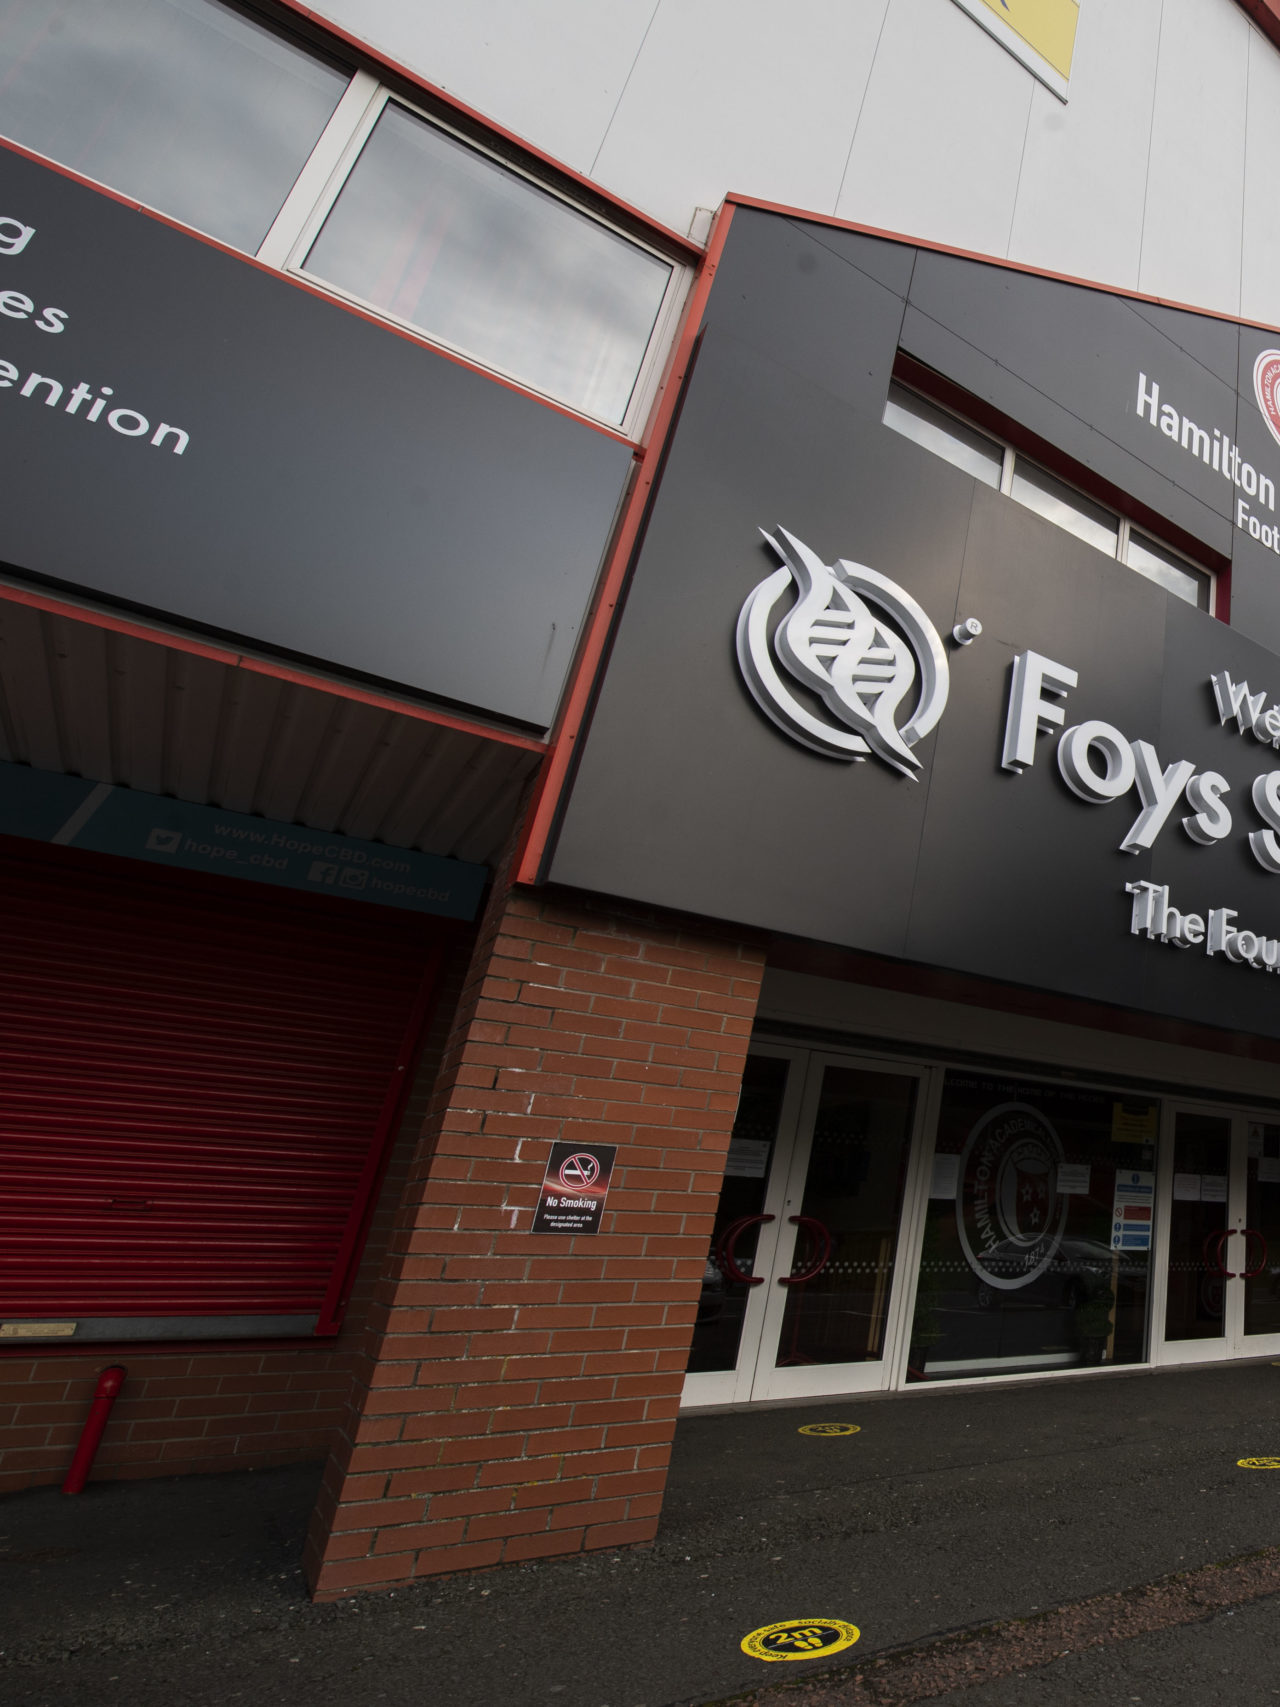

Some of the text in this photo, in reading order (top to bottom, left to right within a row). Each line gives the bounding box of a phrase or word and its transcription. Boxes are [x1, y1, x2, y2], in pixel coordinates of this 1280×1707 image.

[1264, 369, 1276, 415] HAMILTON
[1136, 372, 1275, 511] Hamilton
[1001, 650, 1232, 855] Foys
[184, 837, 289, 871] hope_cbd
[213, 823, 411, 874] www.HopeCBD.com
[370, 875, 450, 902] hopecbd
[1125, 880, 1205, 949] The
[546, 1196, 597, 1211] No Smoking
[769, 1627, 823, 1644] 2m
